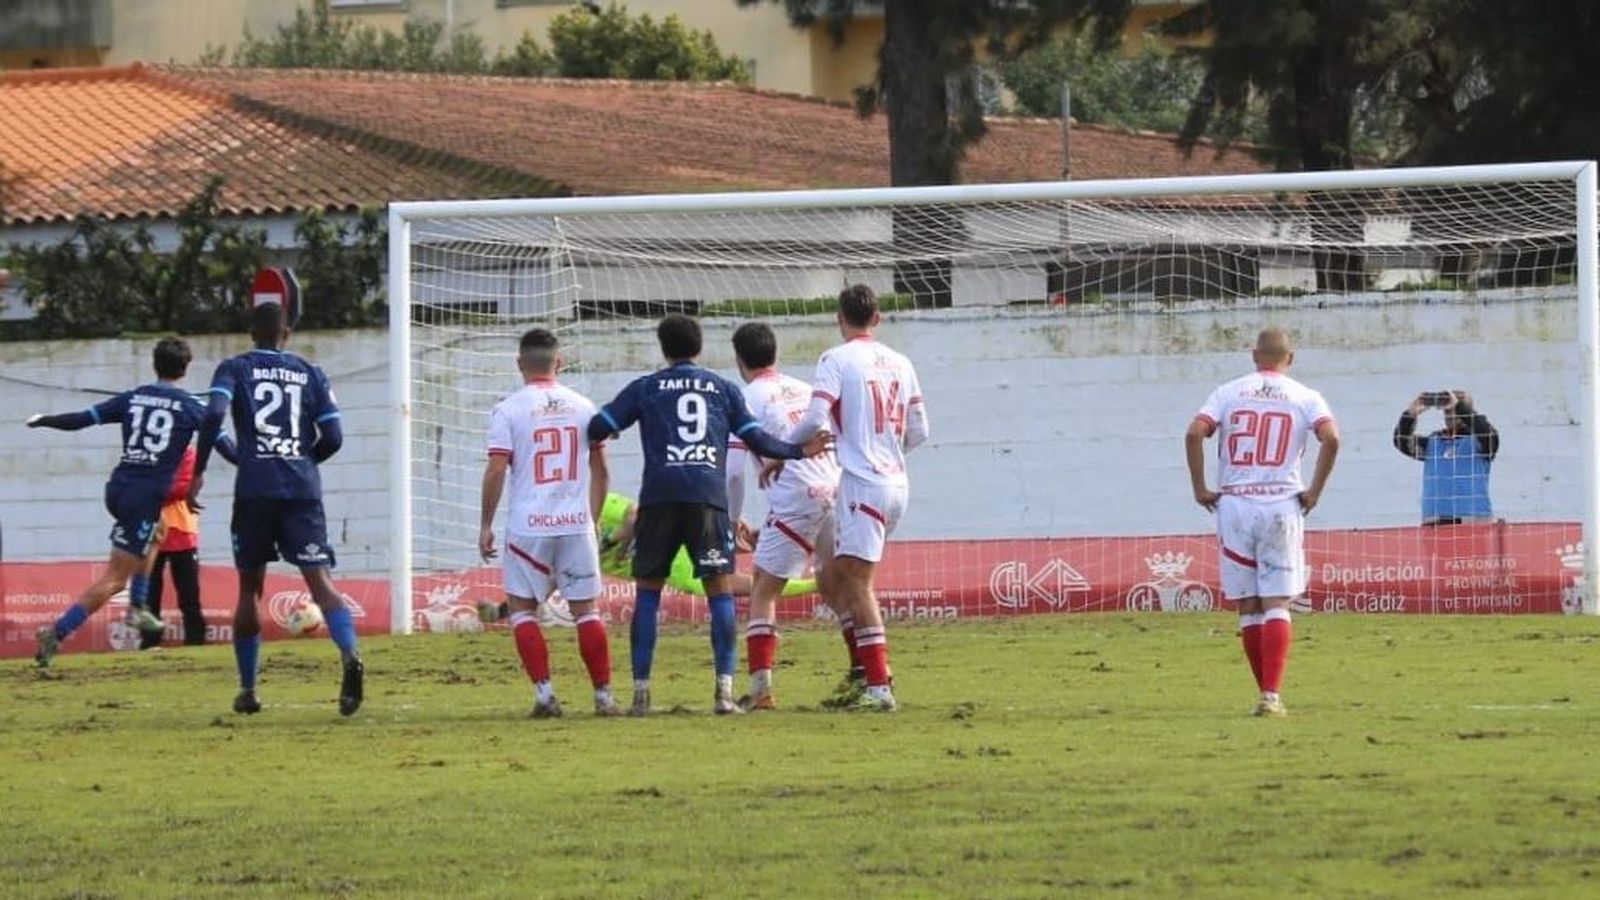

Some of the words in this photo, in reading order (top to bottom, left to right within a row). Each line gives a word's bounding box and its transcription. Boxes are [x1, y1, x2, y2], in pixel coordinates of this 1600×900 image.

[659, 379, 690, 389] ZAKI
[254, 382, 301, 438] 21
[677, 392, 707, 443] 9
[867, 379, 904, 436] 14
[128, 405, 175, 453] 19
[1228, 410, 1293, 467] 20
[533, 426, 578, 484] 21
[527, 512, 576, 528] CHICLANA
[1322, 562, 1425, 587] Diputación
[1445, 557, 1516, 571] PATRONATO
[1444, 575, 1518, 588] PROVINCIAL
[877, 600, 957, 619] hiclana
[1323, 593, 1346, 613] de
[1354, 591, 1405, 613] Cádiz
[1466, 596, 1522, 608] TURISMO
